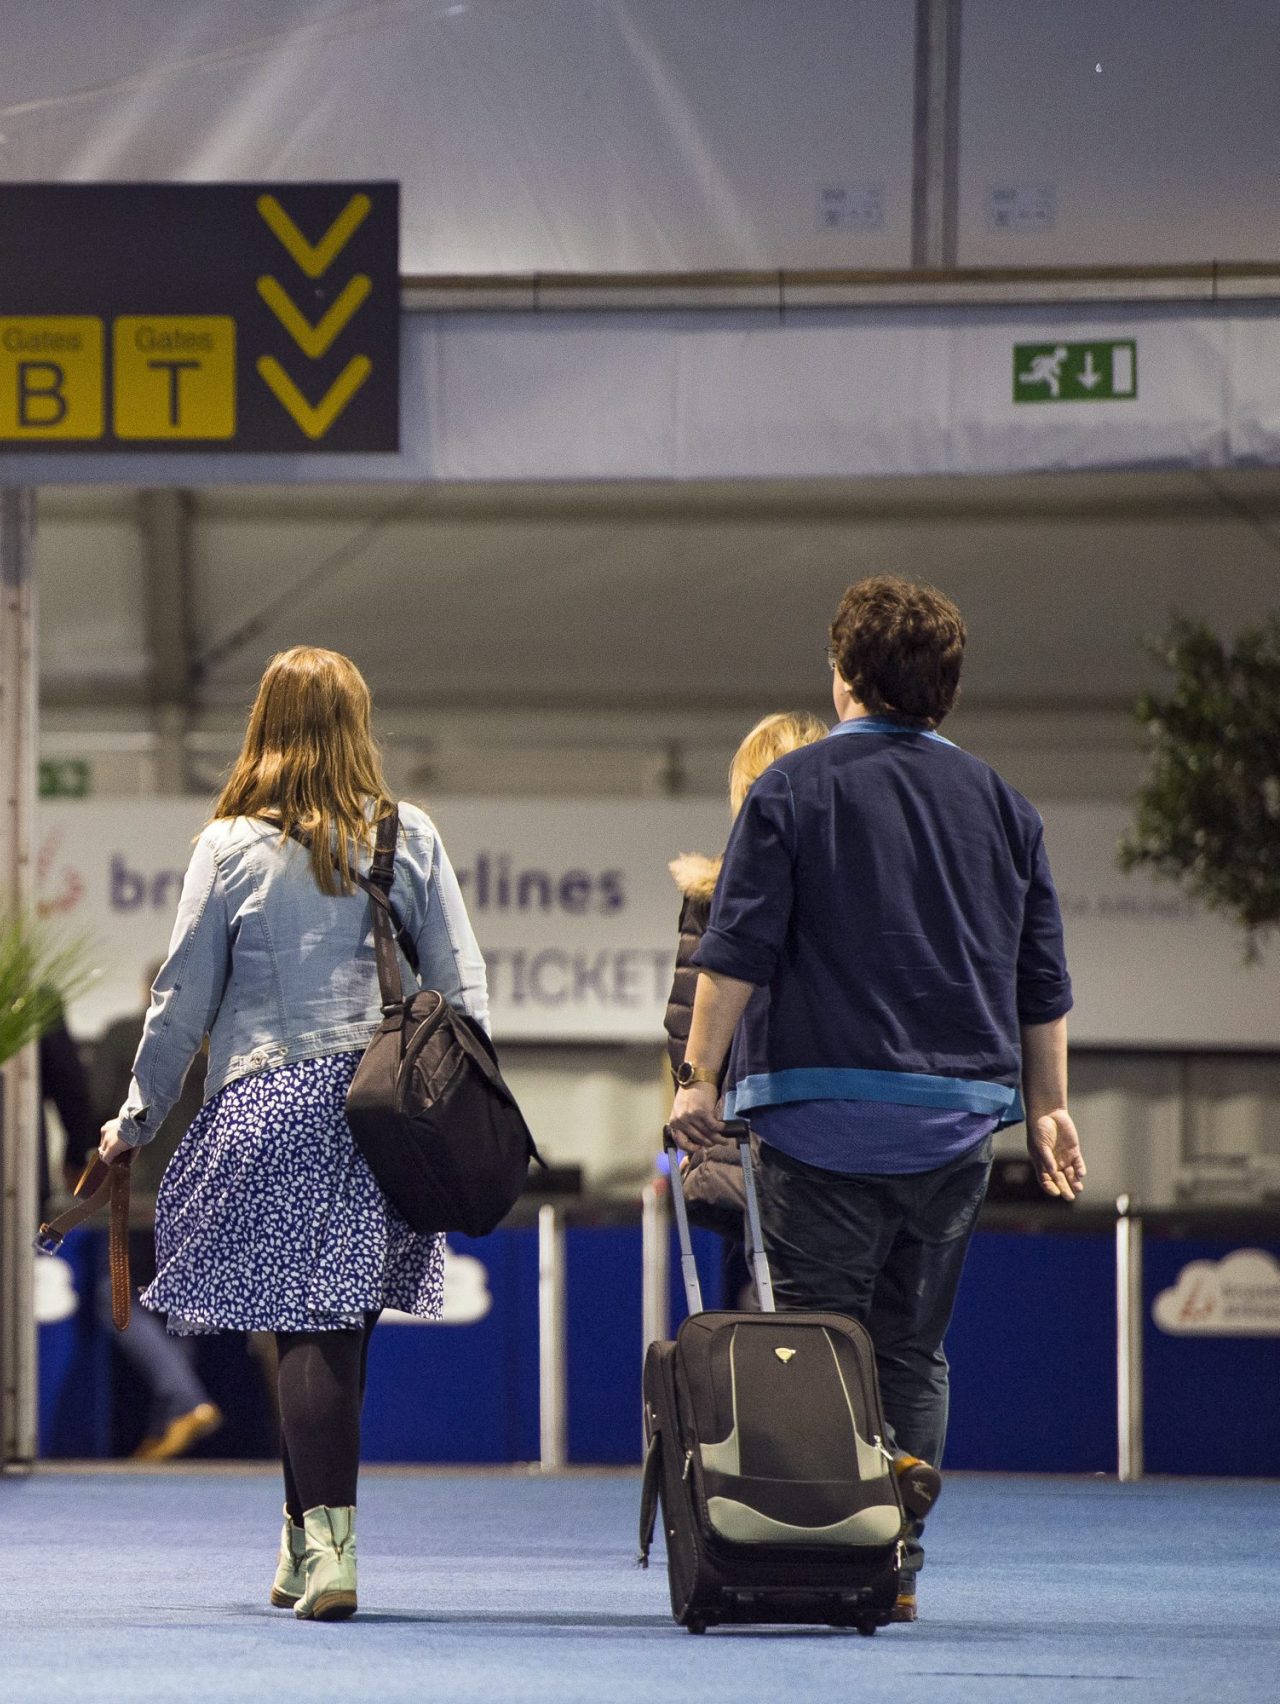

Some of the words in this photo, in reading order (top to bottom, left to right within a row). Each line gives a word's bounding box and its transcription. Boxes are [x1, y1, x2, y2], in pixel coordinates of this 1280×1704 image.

[2, 327, 83, 353] Gates
[134, 326, 215, 353] Gates
[16, 359, 69, 429] B
[146, 359, 202, 428] T
[458, 853, 626, 914] lines
